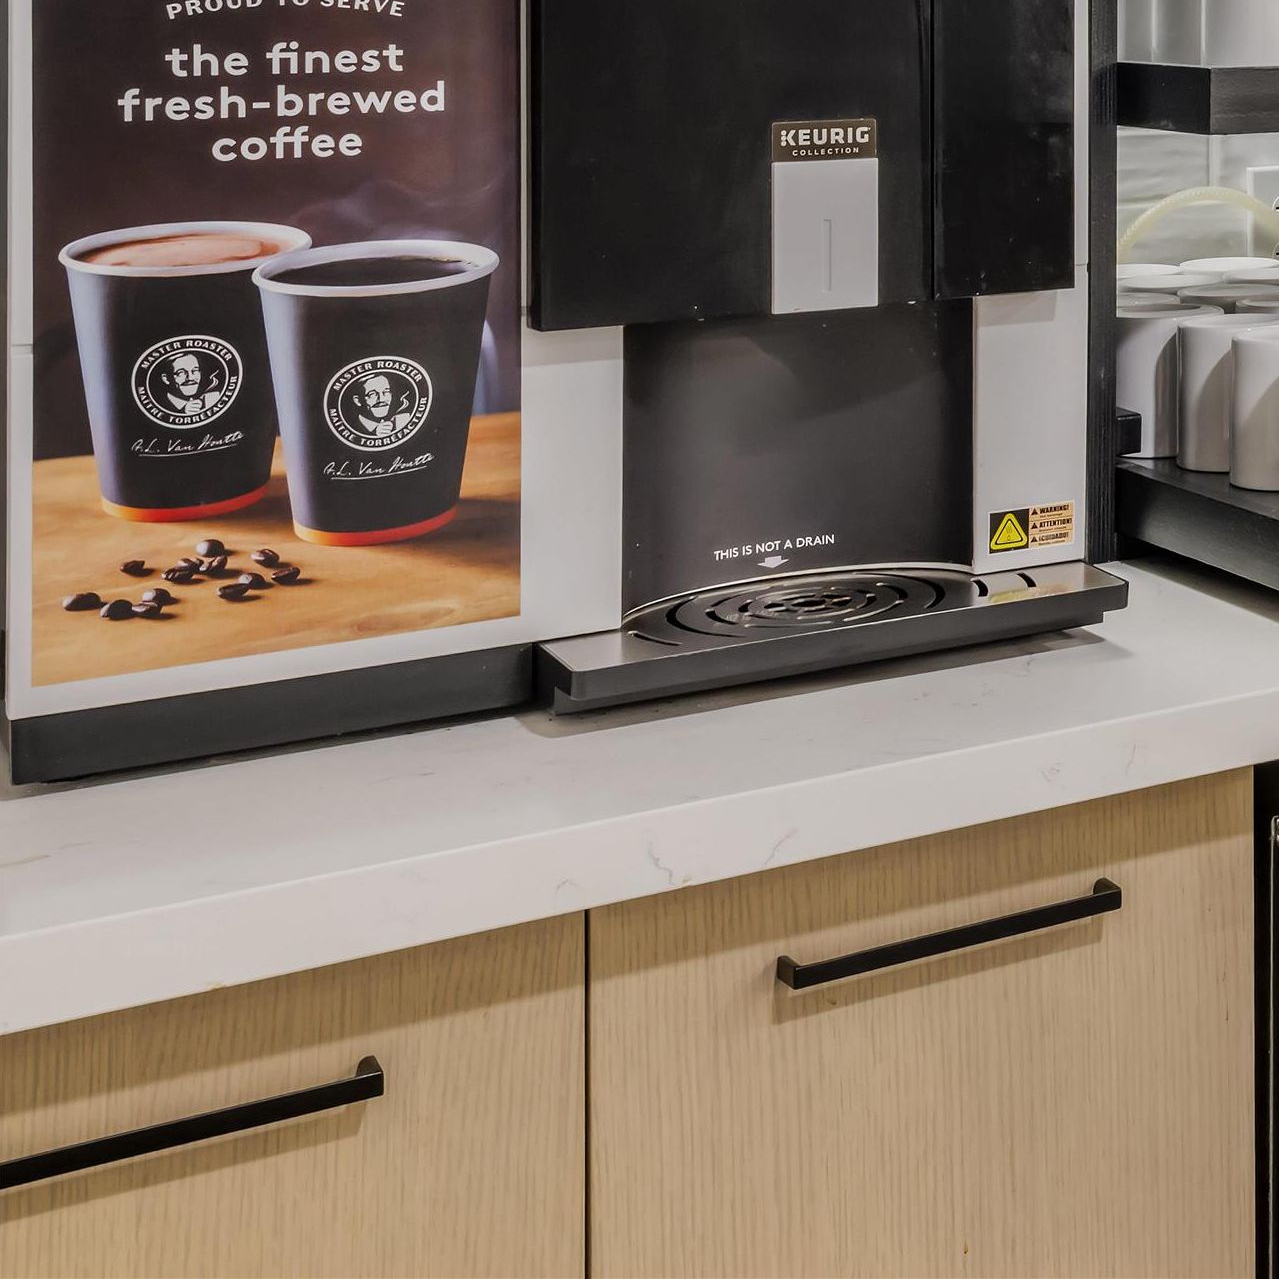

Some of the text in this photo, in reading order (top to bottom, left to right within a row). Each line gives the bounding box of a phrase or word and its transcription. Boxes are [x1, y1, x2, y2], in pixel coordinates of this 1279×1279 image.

[164, 41, 404, 77] the finest
[117, 80, 445, 122] fresh-brewed
[211, 125, 363, 162] coffee
[780, 126, 870, 147] KEURIG
[792, 147, 859, 156] COLLECTION
[141, 340, 233, 369] MASTER ROASTER
[333, 360, 423, 391] MASTER ROASTER
[167, 438, 194, 453] Van
[197, 430, 244, 451] Houtte
[359, 461, 385, 475] Van
[388, 452, 435, 473] Houtte
[1039, 504, 1070, 514] WARNING!
[1039, 518, 1073, 528] ATTENTION!
[714, 534, 835, 561] THIS IS NOT A DRAIN
